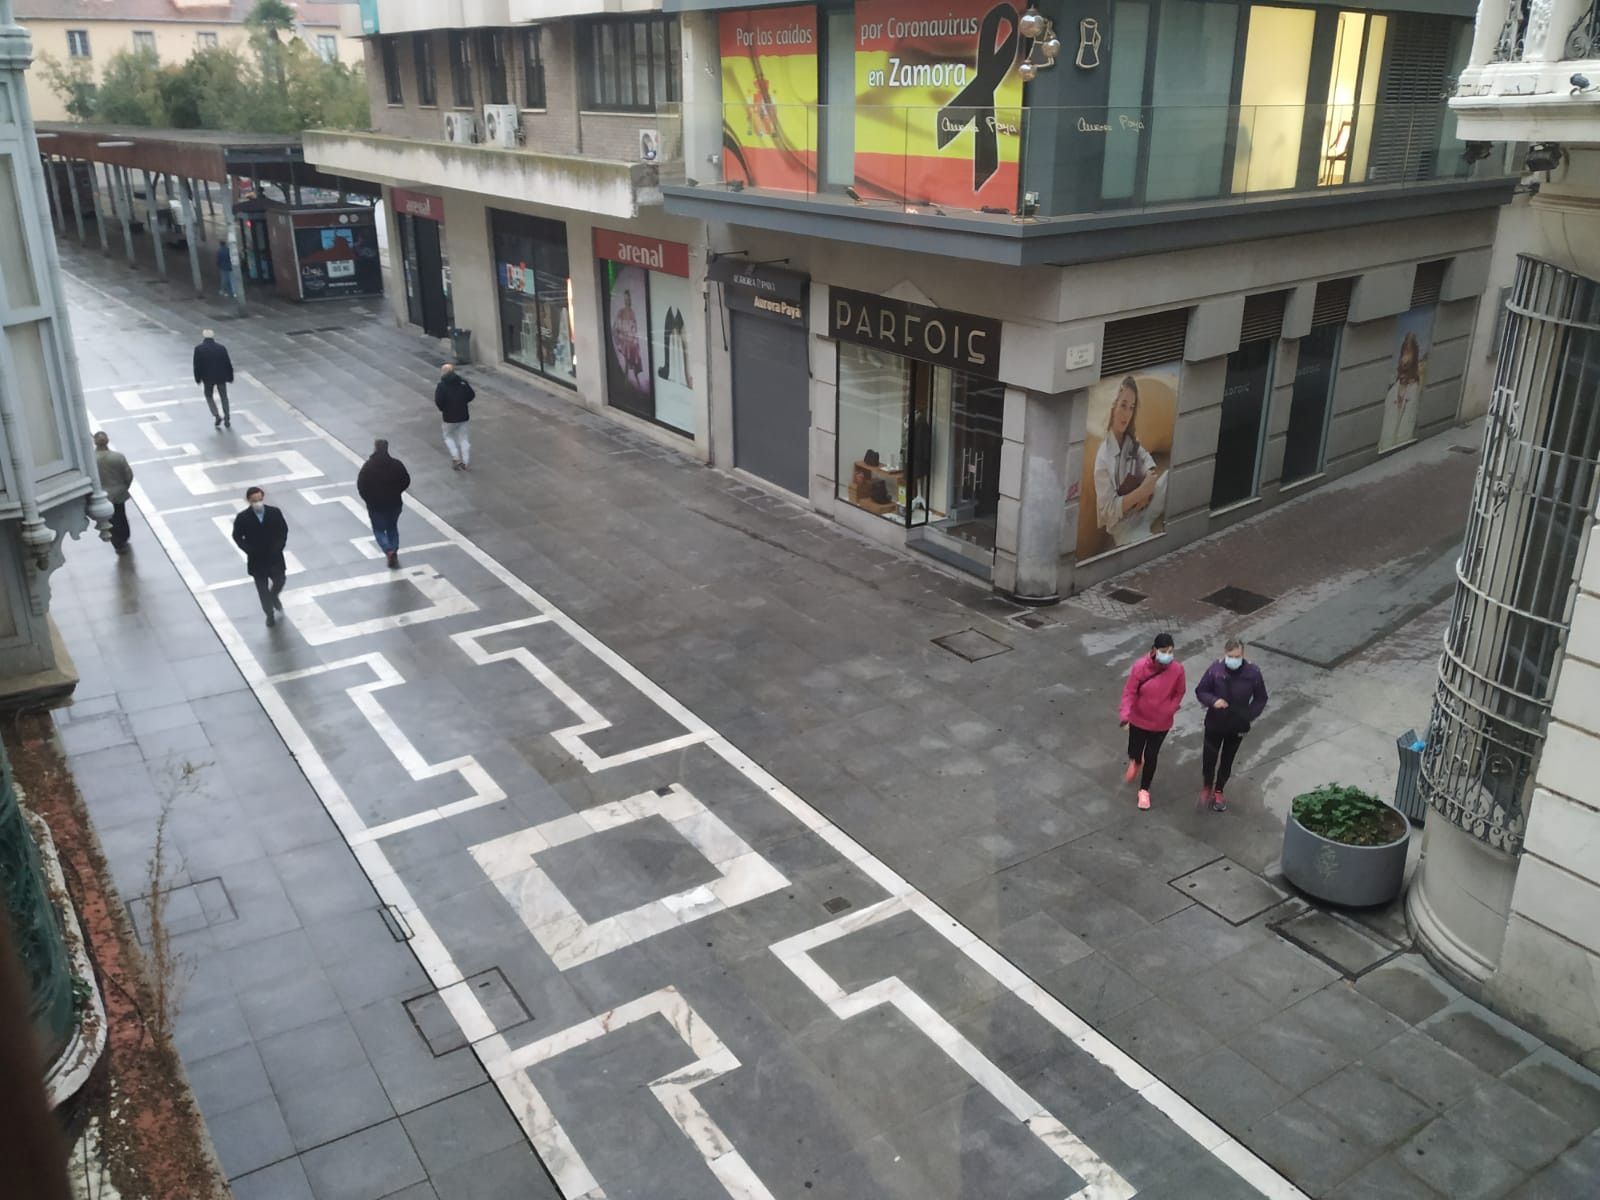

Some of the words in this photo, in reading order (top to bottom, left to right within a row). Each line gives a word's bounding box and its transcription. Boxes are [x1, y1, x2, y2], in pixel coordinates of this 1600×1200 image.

[736, 27, 754, 47] Por
[776, 23, 812, 45] caídos
[861, 22, 883, 46] por
[887, 12, 978, 39] Coronavirus
[868, 70, 884, 87] en
[888, 57, 966, 87] Zamora
[617, 243, 664, 269] arenal
[754, 295, 780, 313] Aurora
[835, 299, 987, 365] PARFOIS
